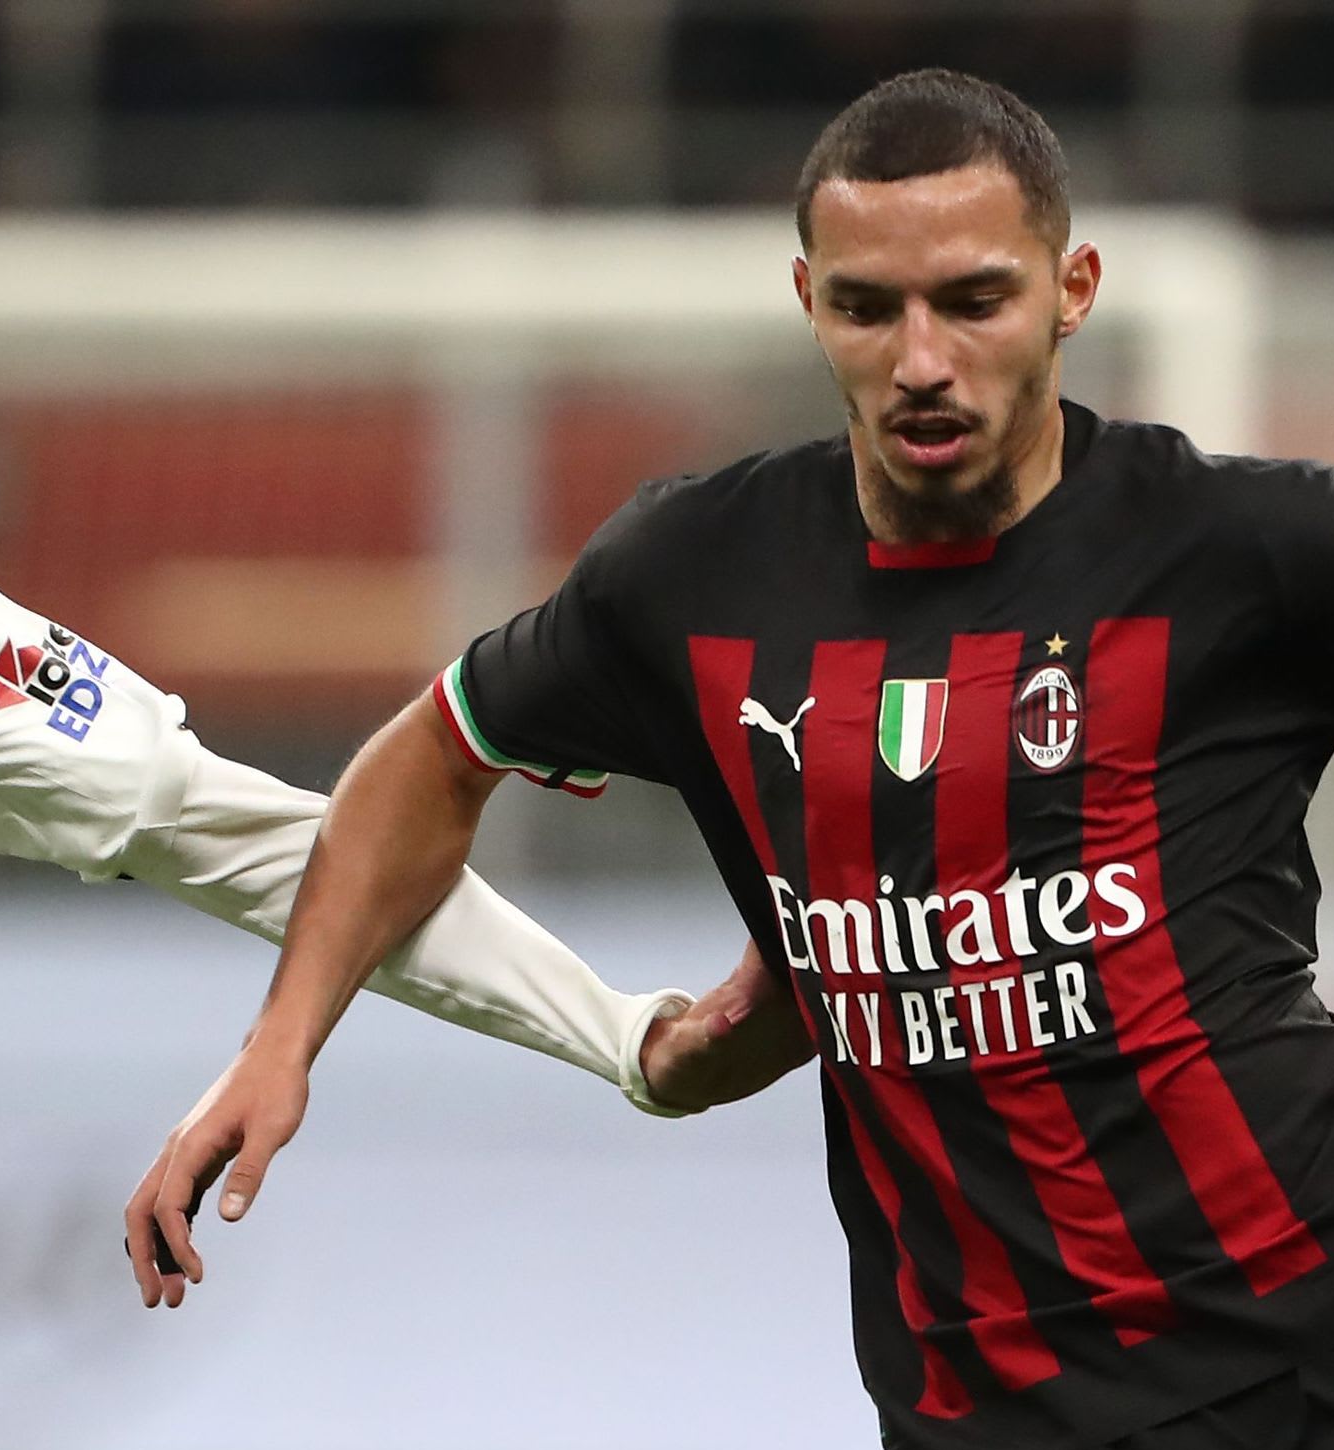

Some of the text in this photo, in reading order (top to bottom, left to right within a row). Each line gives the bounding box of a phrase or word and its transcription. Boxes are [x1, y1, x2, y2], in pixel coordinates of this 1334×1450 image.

[1030, 748, 1063, 760] 1899
[766, 863, 1147, 974] Emirates
[900, 961, 1097, 1066] BETTER
